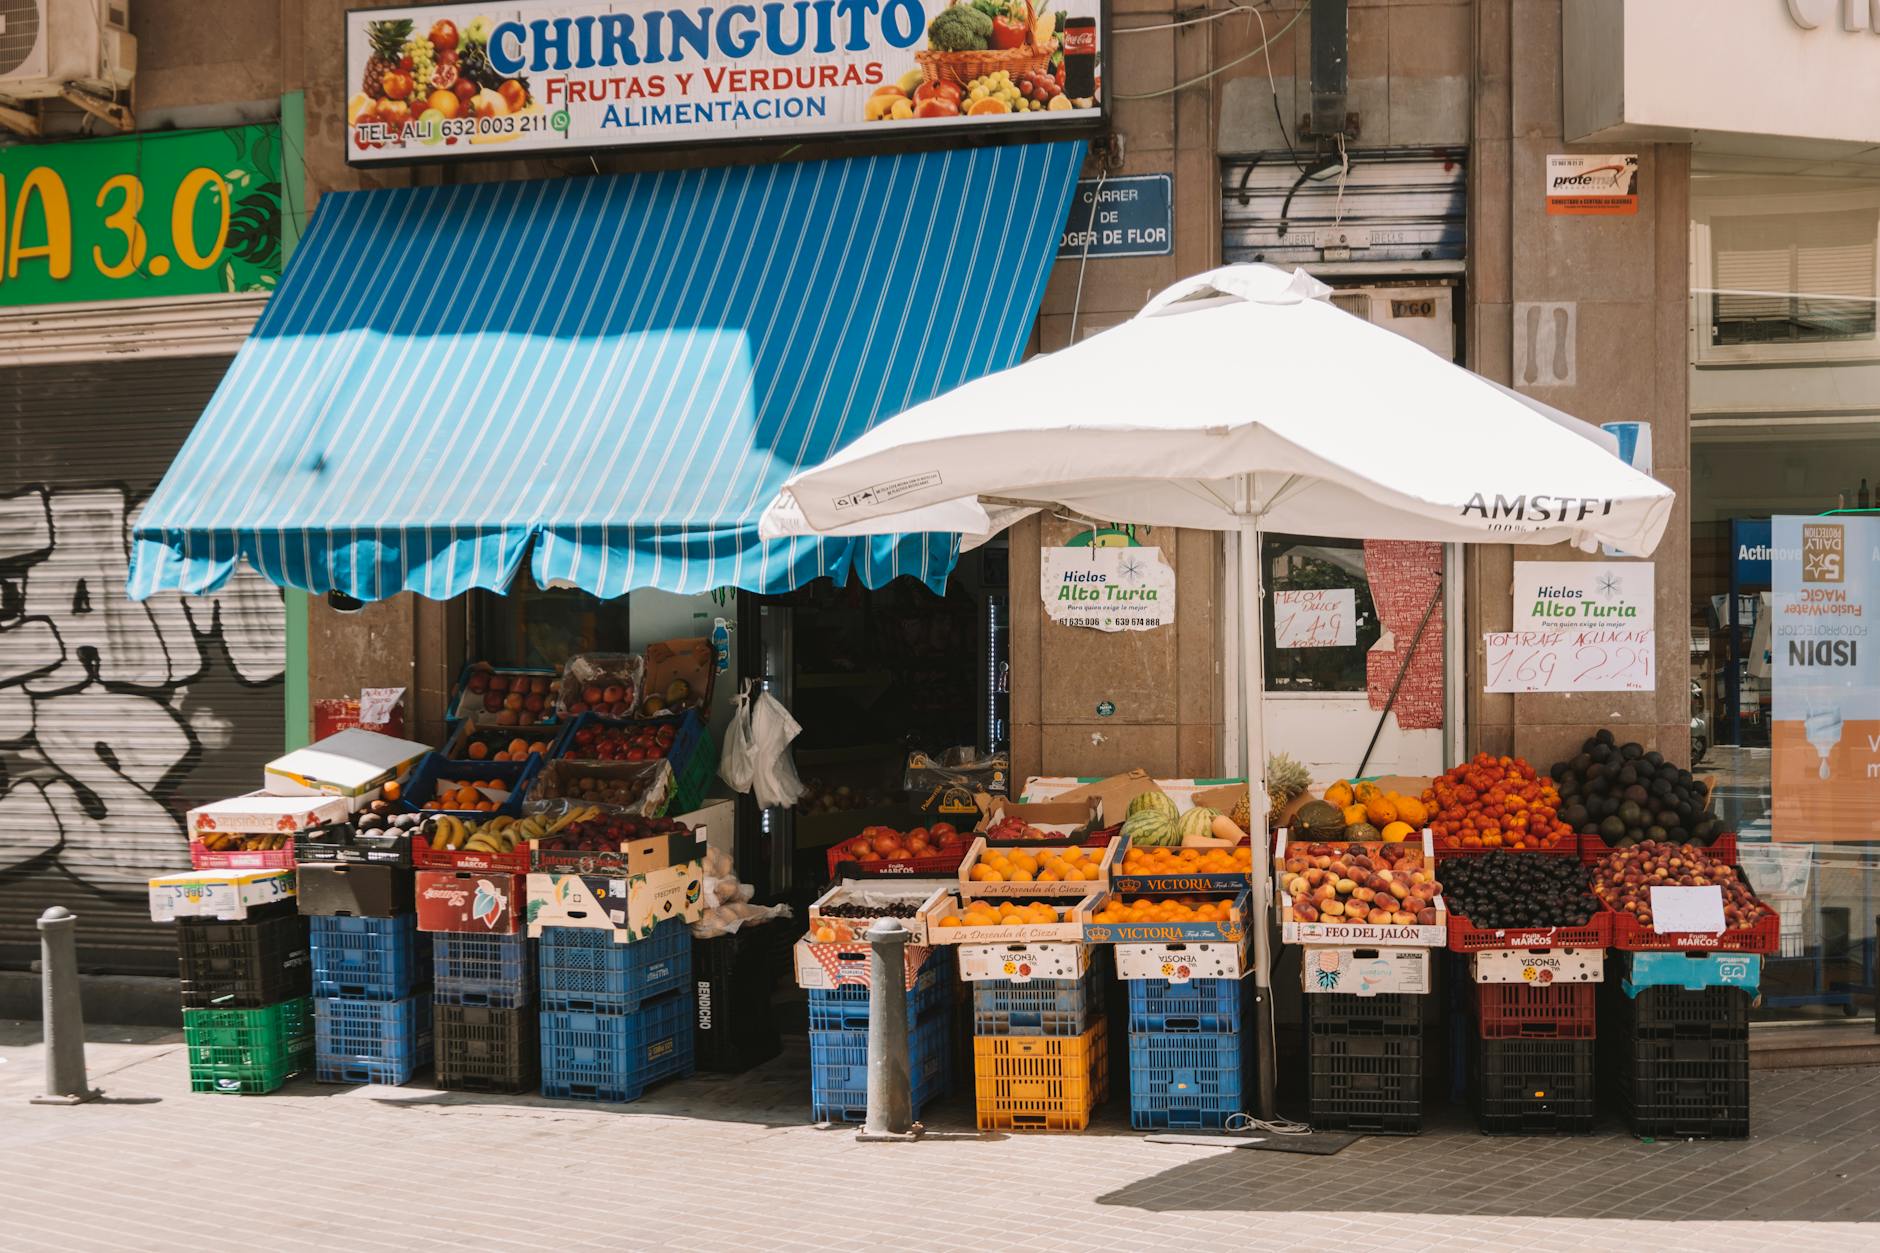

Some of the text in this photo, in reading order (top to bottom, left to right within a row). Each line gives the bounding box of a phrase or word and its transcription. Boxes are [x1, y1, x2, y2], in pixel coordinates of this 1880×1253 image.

[487, 0, 926, 75] CHIRINGUITO
[546, 62, 883, 105] FRUTAS Y VERDURAS
[600, 96, 826, 129] ALIMENTACION
[358, 115, 547, 141] TEL. ALI 632 003 211
[1083, 189, 1138, 203] CARRER
[0, 166, 230, 281] A 3.0
[1100, 211, 1118, 223] DE
[1059, 228, 1166, 247] OGER DE FLOR
[1805, 527, 1842, 538] PROTECTION
[1805, 538, 1841, 550] DAILY
[1824, 554, 1840, 580] 5
[1064, 570, 1107, 582] Hielos
[1058, 584, 1158, 601] Alto Turia
[1537, 586, 1583, 598] Hielos
[1801, 589, 1846, 601] MAGIC
[1531, 600, 1637, 617] Alto Turia
[1784, 604, 1862, 617] FusionWater
[1115, 618, 1129, 626] 639
[1131, 618, 1144, 626] 674
[1777, 625, 1868, 636] FOTOPROTECTOR
[1789, 640, 1857, 666] ISDIN
[1490, 649, 1557, 687] 1.69
[457, 860, 488, 869] MARCOS
[1043, 884, 1056, 895] de
[1147, 878, 1212, 891] VICTORIA
[1015, 929, 1028, 939] de
[1117, 927, 1184, 940] VICTORIA
[1325, 928, 1350, 938] FEO
[1352, 928, 1378, 938] DEL
[1379, 926, 1420, 941] JALÓN
[1511, 937, 1552, 946] MARCOS
[1677, 938, 1719, 946] MARCOS
[1000, 954, 1037, 962] VENOSTA
[1158, 955, 1197, 963] VENOSTA
[1520, 958, 1560, 966] VENOSTA
[697, 981, 712, 1030] BENDICHO
